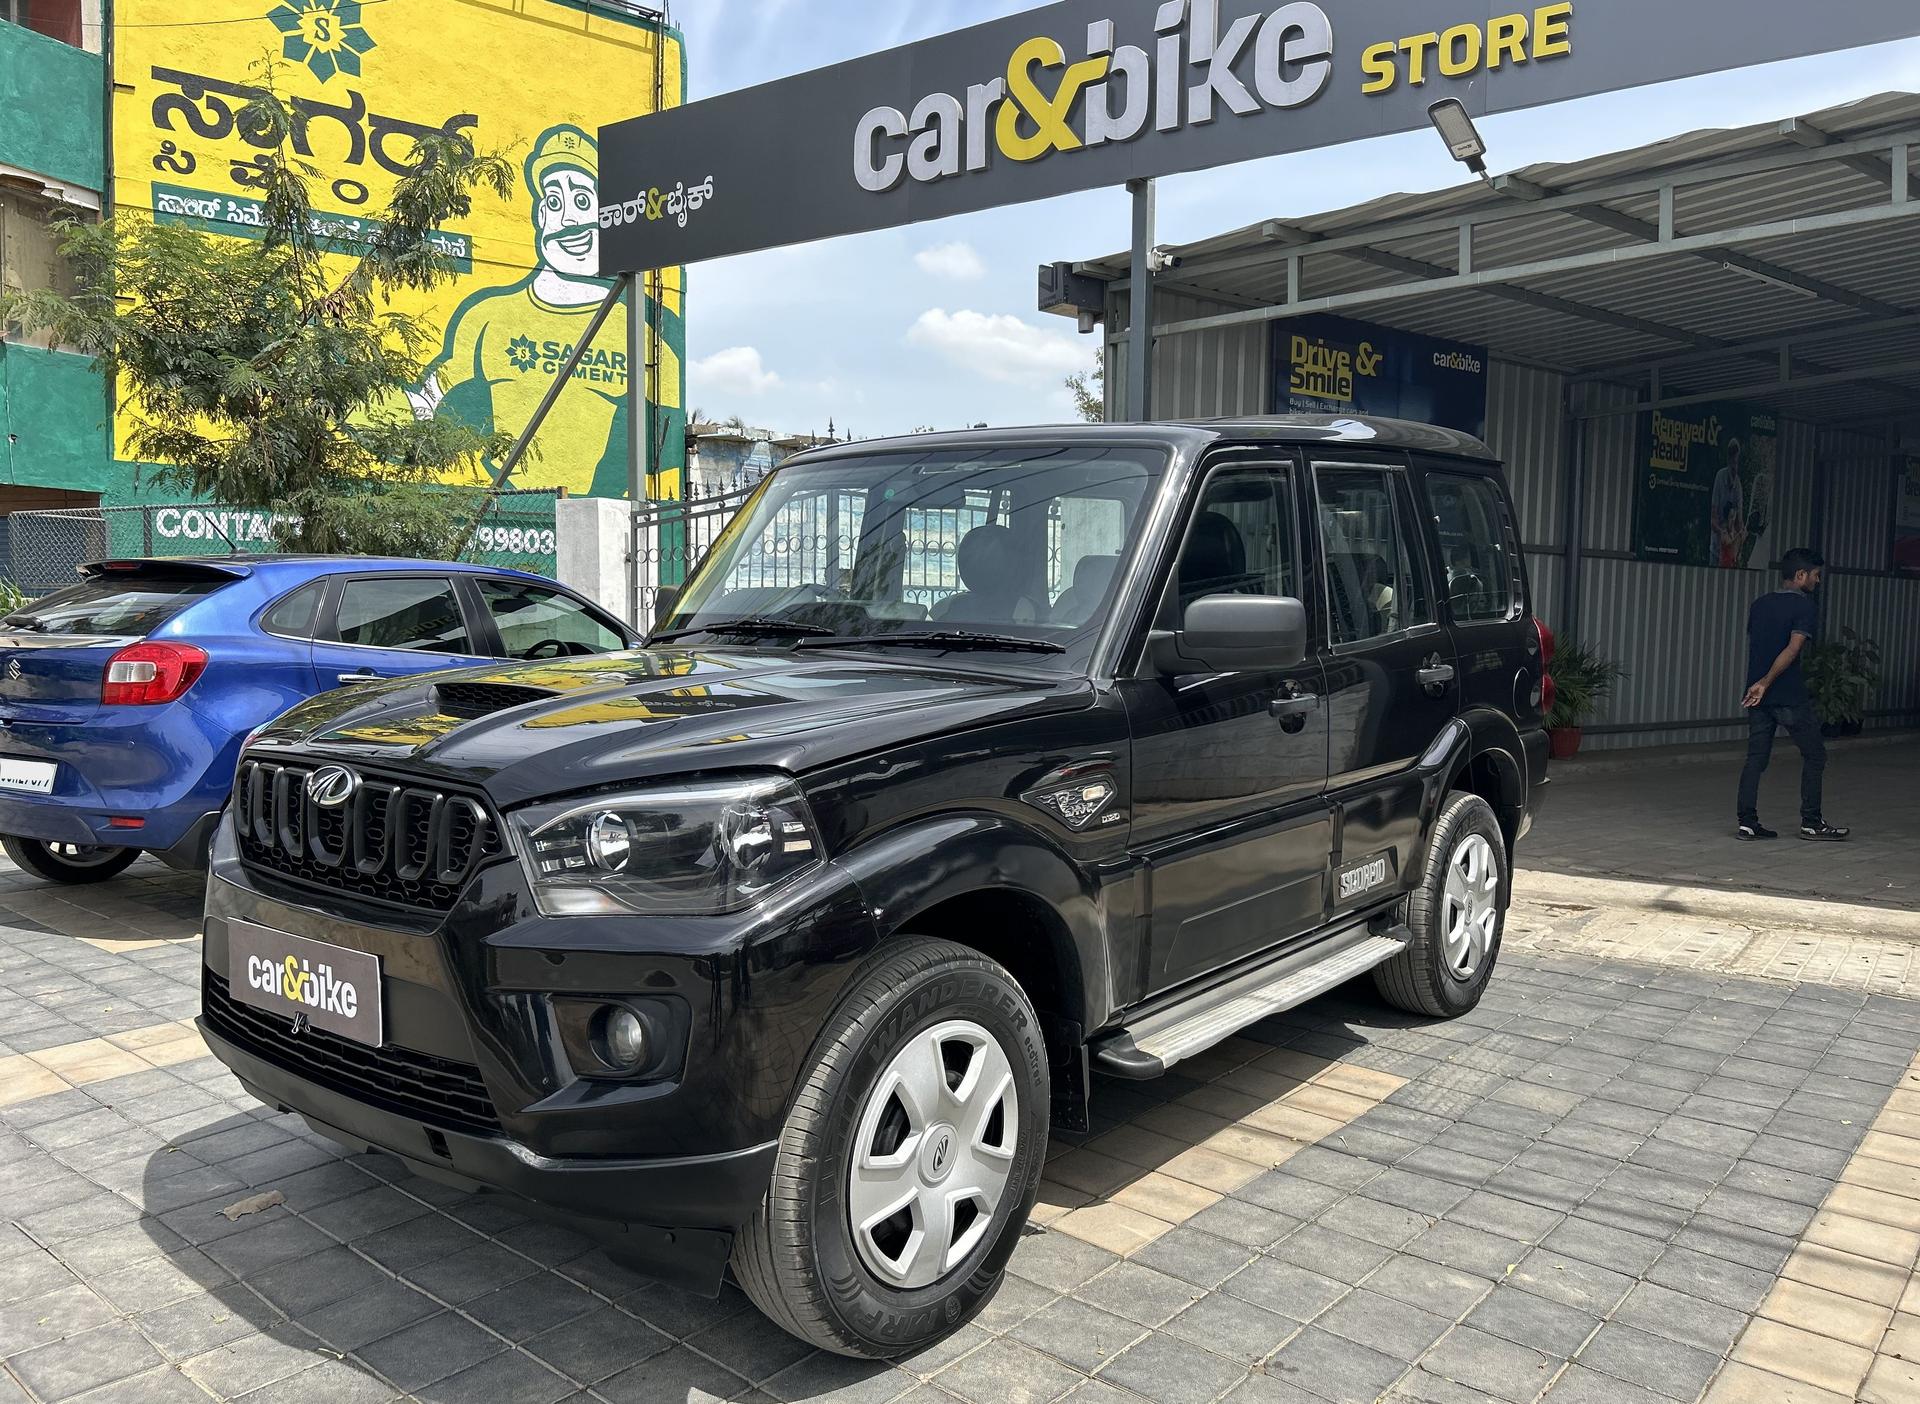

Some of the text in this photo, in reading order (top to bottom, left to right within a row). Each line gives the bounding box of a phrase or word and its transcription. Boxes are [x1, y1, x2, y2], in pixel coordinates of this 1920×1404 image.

[314, 17, 330, 42] S
[853, 0, 1573, 191] car&bike STORE
[1291, 336, 1383, 376] Drive &
[1433, 351, 1480, 373] car&bike
[543, 361, 627, 385] CMENT
[1290, 362, 1350, 396] Smile
[1652, 410, 1705, 443] Renewed
[248, 955, 357, 1018] car&bike
